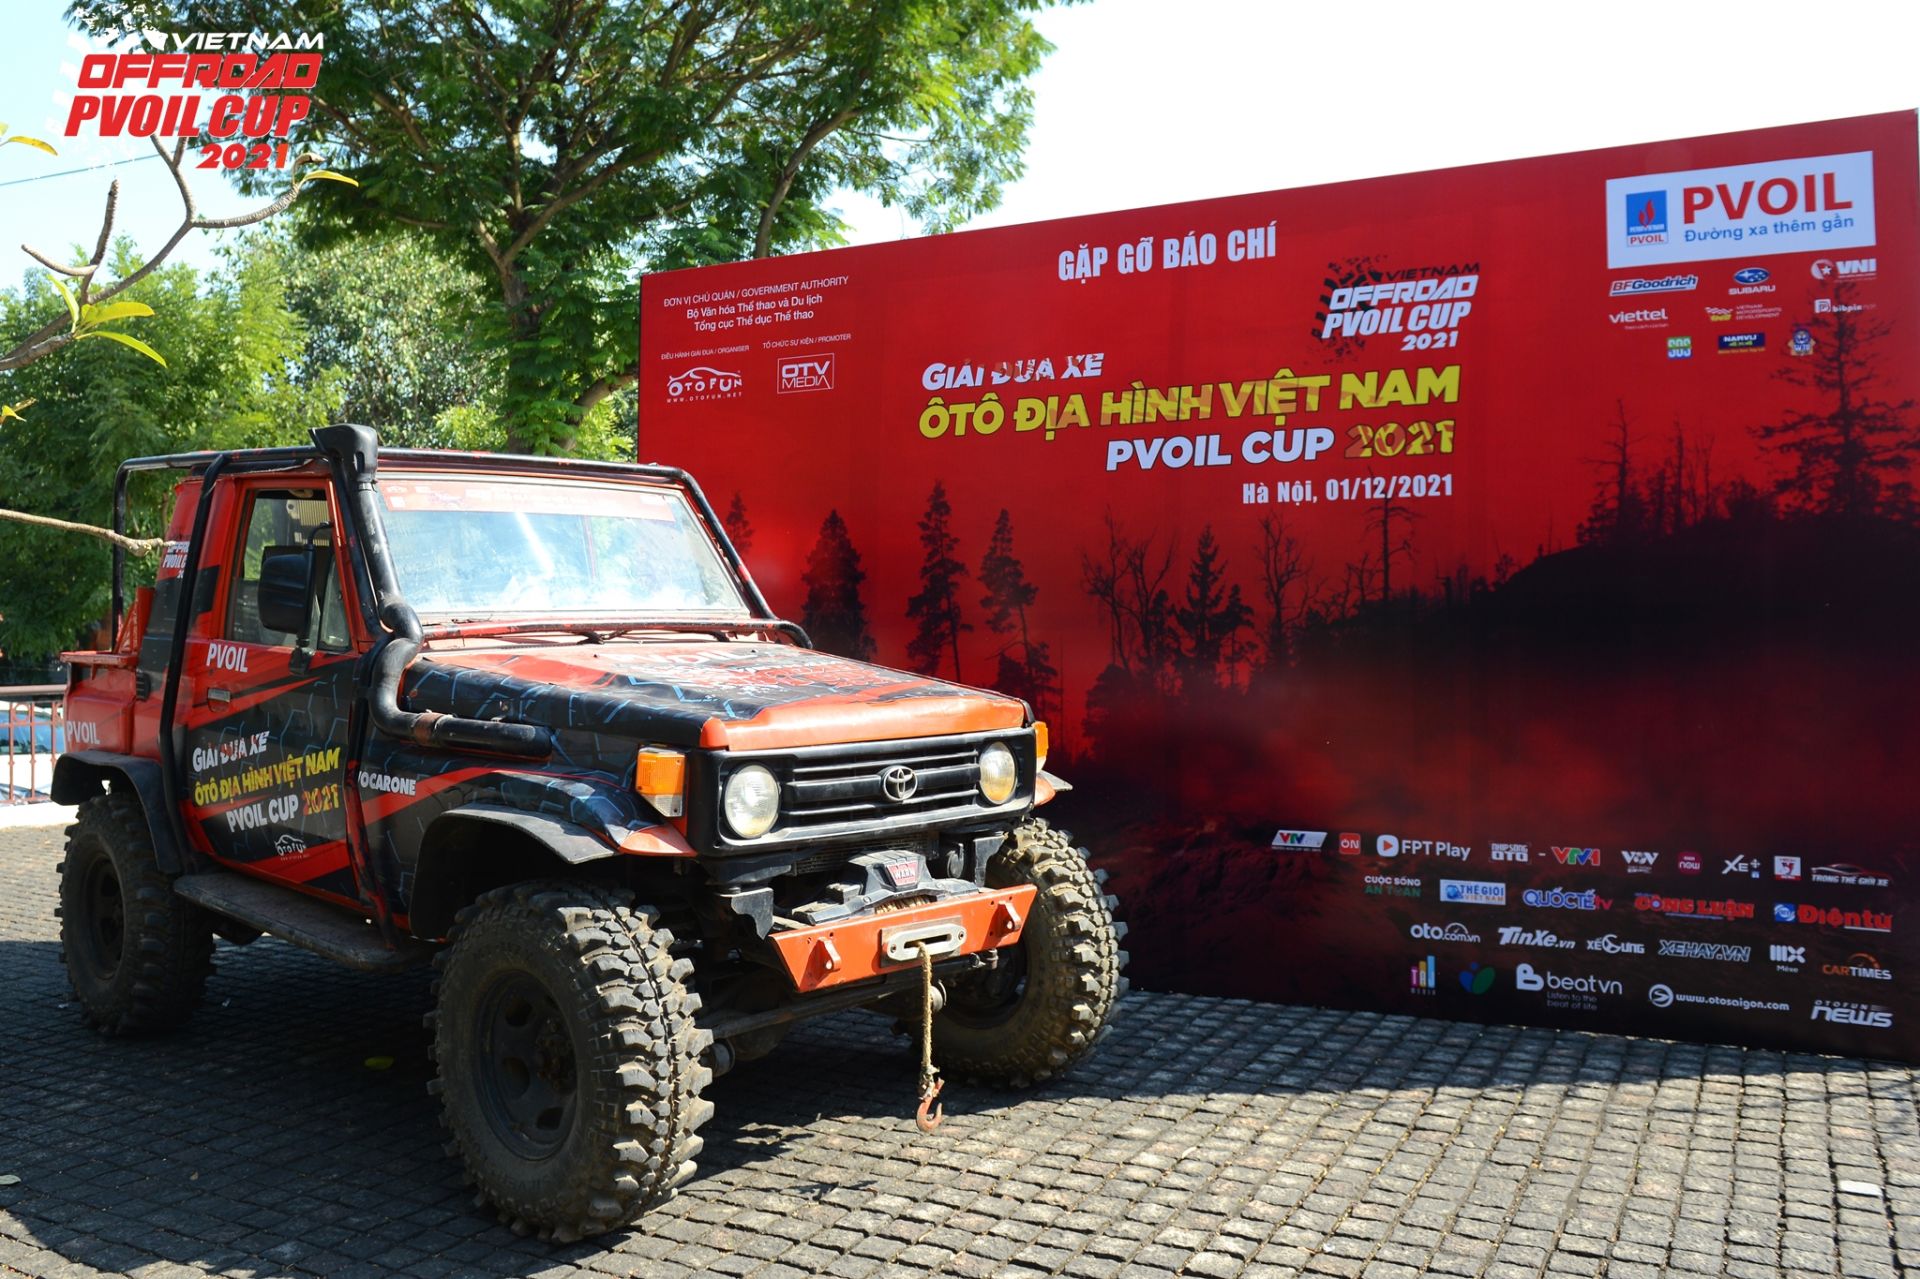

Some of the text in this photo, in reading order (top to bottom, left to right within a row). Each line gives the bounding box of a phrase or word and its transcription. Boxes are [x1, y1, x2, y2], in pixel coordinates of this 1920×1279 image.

[1683, 172, 1853, 225] PVOIL
[1685, 223, 1743, 242] Đường
[1749, 225, 1768, 237] xa
[1773, 217, 1816, 234] thêm
[1822, 213, 1854, 232] gần
[1630, 234, 1664, 245] PVOIL
[1058, 220, 1278, 285] GẶP GỠ BÁO CHÍ
[1385, 262, 1480, 281] VIETNAM
[1836, 258, 1877, 274] VNI
[741, 282, 799, 297] GOVERNMENT
[800, 276, 849, 290] AUTHORITY
[1329, 274, 1479, 310] OFFROAD
[1612, 276, 1696, 292] BFGoodrich
[1728, 285, 1776, 296] SUBARU
[718, 304, 735, 315] hóa
[755, 301, 776, 311] thao
[778, 297, 789, 308] và
[791, 296, 804, 307] Du
[806, 294, 823, 306] lịch
[718, 319, 734, 330] cục
[754, 314, 772, 325] dục
[793, 310, 814, 320] thao
[1321, 301, 1472, 339] PVOIL CUP
[1608, 308, 1668, 324] viettel
[1400, 330, 1459, 351] 2021
[782, 361, 830, 378] OTV
[921, 352, 1105, 391] GIẢI ĐUA XE
[669, 378, 743, 397] OTOFUN
[782, 375, 831, 389] MEDIA
[918, 364, 1461, 441] ÔTÔ ĐỊA HÌNH VIỆT NAM
[1105, 420, 1456, 472] PVOIL CUP 2021
[1242, 473, 1453, 507] Hà Nội, 01/12/2021
[206, 643, 249, 674] PVOIL
[66, 720, 100, 745] PVOIL
[192, 731, 270, 773] GIẢI ĐUA XE
[194, 747, 341, 806] ÔTÔ ĐỊA HÌNH VIỆT NAM
[226, 783, 339, 833] PVOIL CUP 2021
[1401, 839, 1471, 862] FPT Play
[1551, 846, 1601, 866] VTV1
[1621, 850, 1659, 865] VOV
[1410, 922, 1481, 943] oto.com.vn
[1498, 926, 1576, 949] TinXe.vn
[1658, 939, 1751, 963] XEHAY.VN
[1675, 993, 1790, 1011] www.otosaigon.com
[1814, 999, 1868, 1011] OTOFUN
